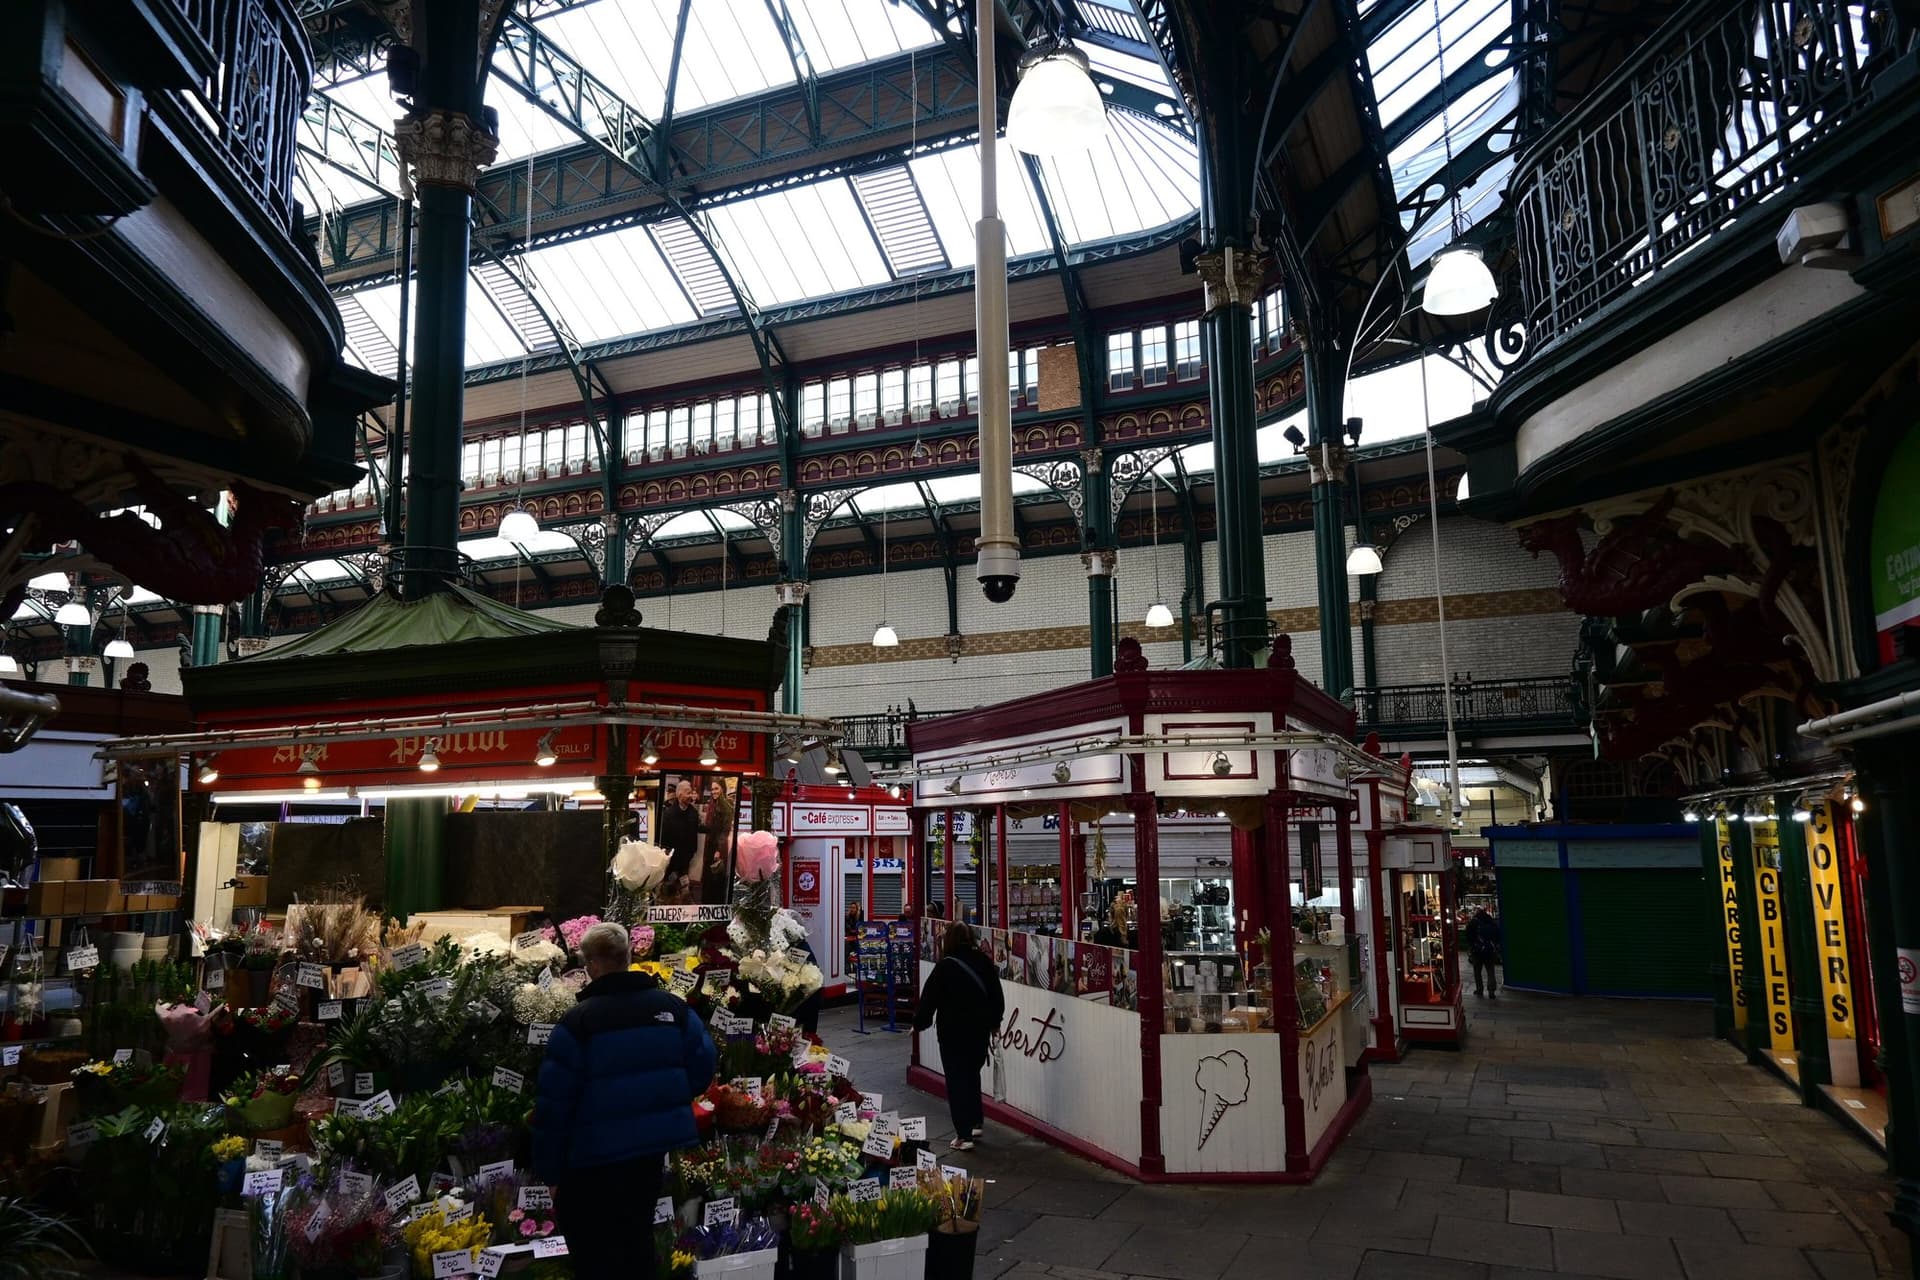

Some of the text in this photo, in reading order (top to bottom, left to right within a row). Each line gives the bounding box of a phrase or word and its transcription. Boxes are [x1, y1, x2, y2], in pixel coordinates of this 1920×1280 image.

[658, 729, 738, 749] Flowrs
[555, 745, 580, 754] STALL
[808, 812, 855, 826] Café express
[649, 907, 682, 921] FLOWERS
[1809, 806, 1849, 1023] COVERS
[1720, 845, 1747, 1006] CHARGERS
